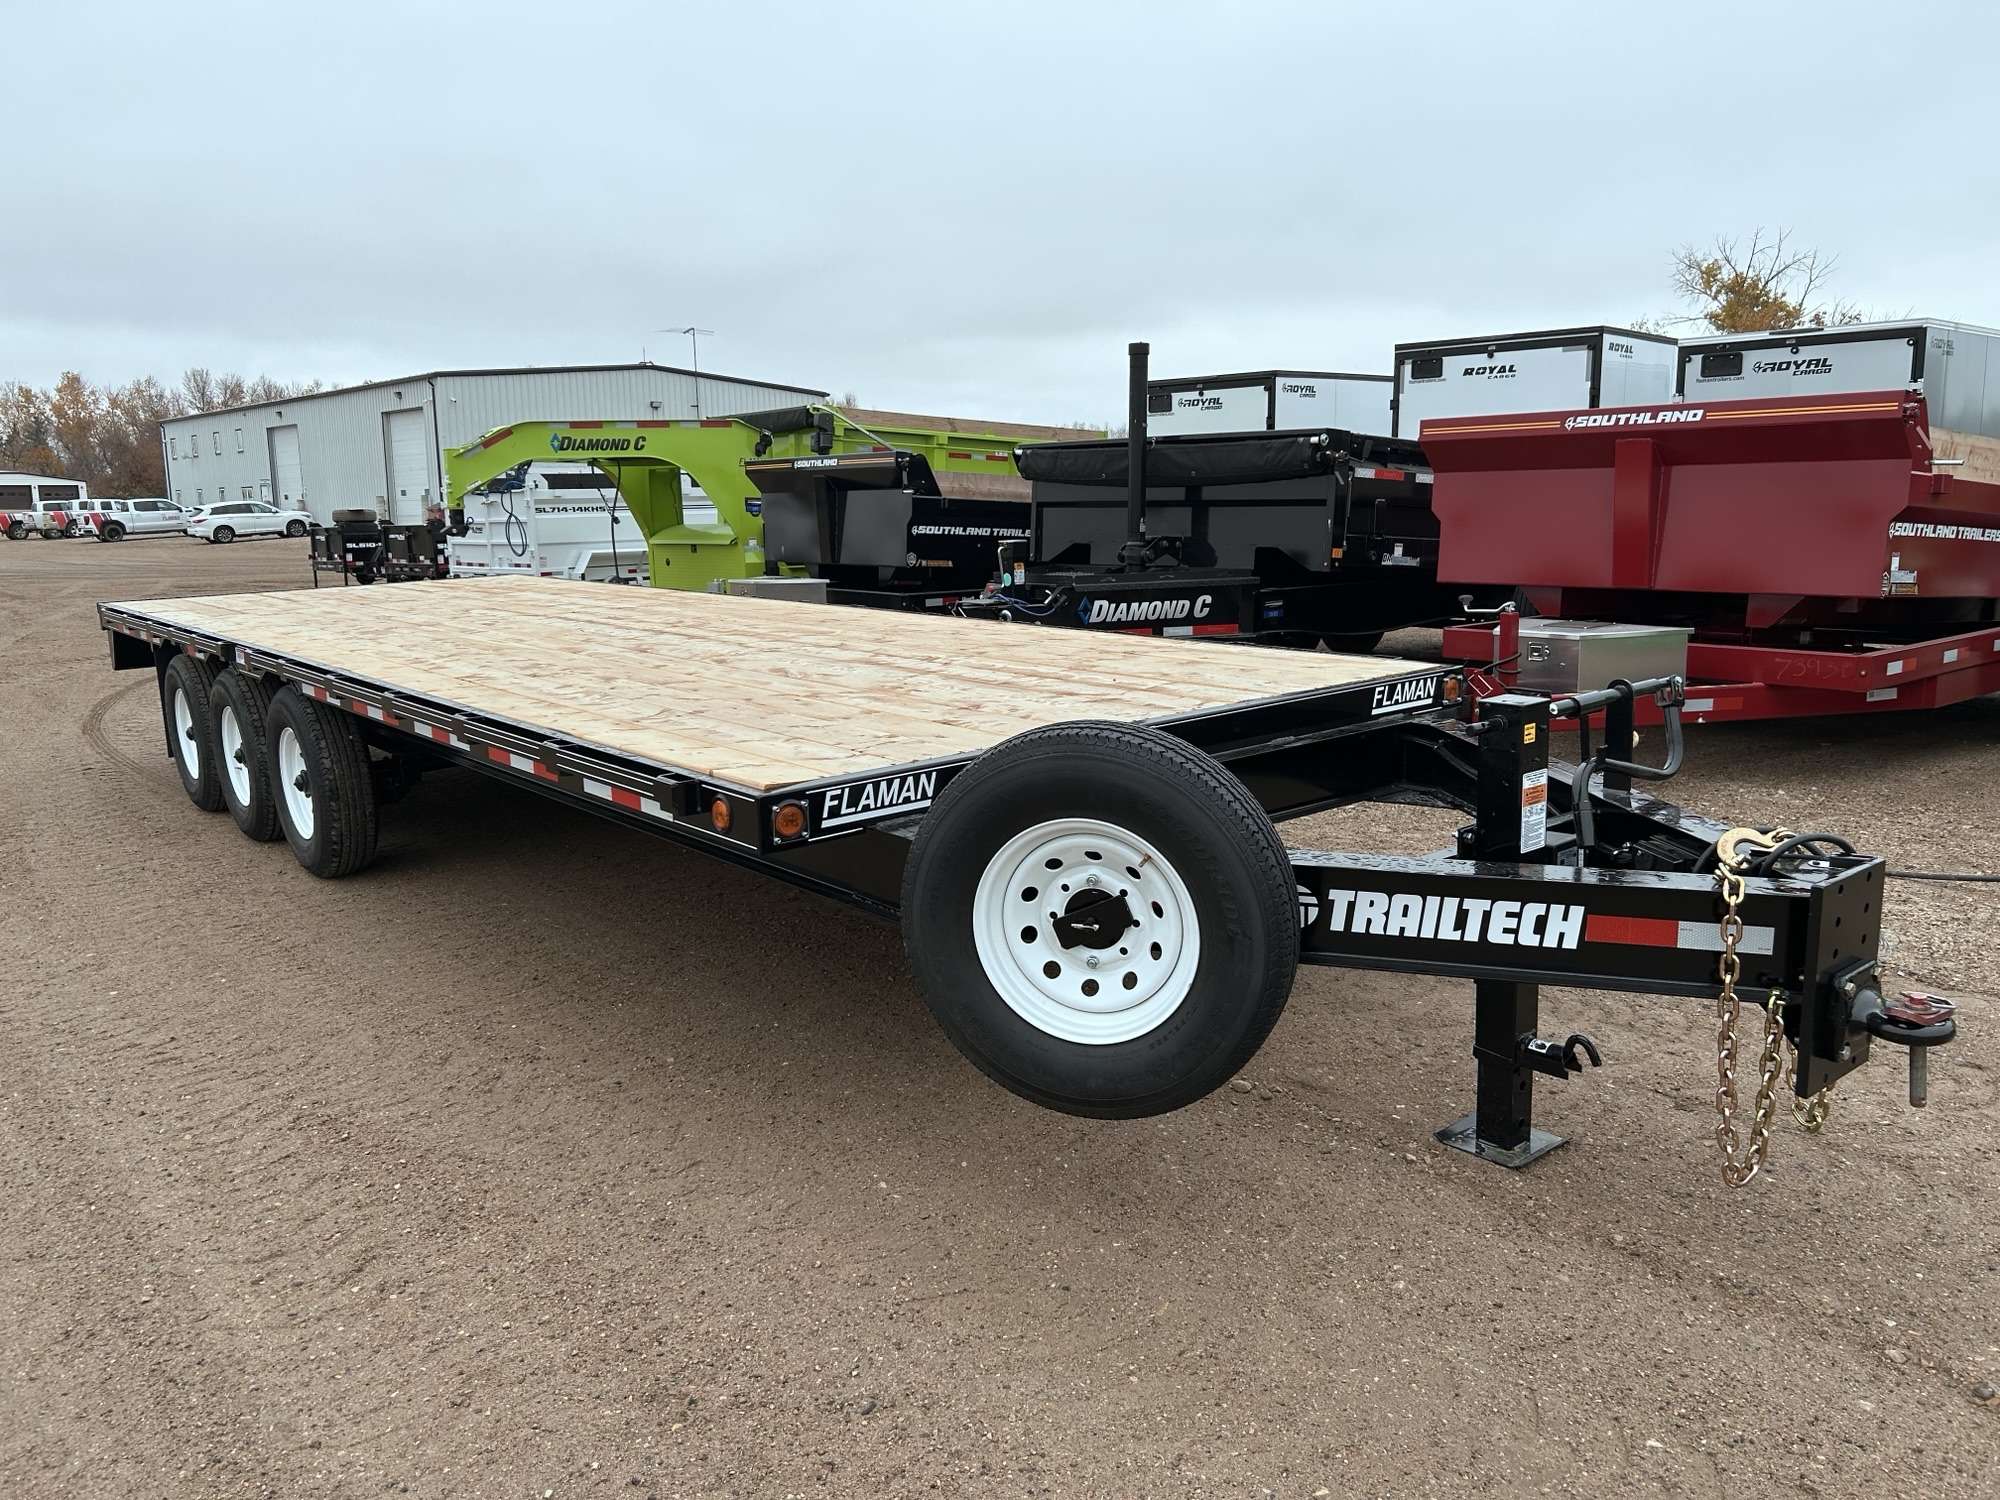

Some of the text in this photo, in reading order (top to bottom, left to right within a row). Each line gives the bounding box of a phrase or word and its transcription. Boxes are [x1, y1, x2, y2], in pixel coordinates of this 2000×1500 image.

[1608, 342, 1633, 354] ROYAL
[1462, 364, 1517, 377] ROYAL
[1761, 357, 1833, 373] ROYAL
[1792, 367, 1832, 376] CARGO
[1286, 384, 1317, 394] ROYAL
[1182, 397, 1223, 408] ROYAL
[1573, 409, 1705, 428] SOUTHLAND
[559, 435, 647, 451] DIAMOND C
[796, 458, 838, 468] SOUTHLAND
[917, 525, 992, 536] SOUTHLAND
[1893, 522, 2000, 542] SOUTHLAND TRAILERS
[1088, 594, 1212, 624] DIAMOND C
[1372, 677, 1437, 708] FLAMAN
[822, 771, 937, 819] FLAMAN
[1328, 888, 1586, 950] TRAILTECH
